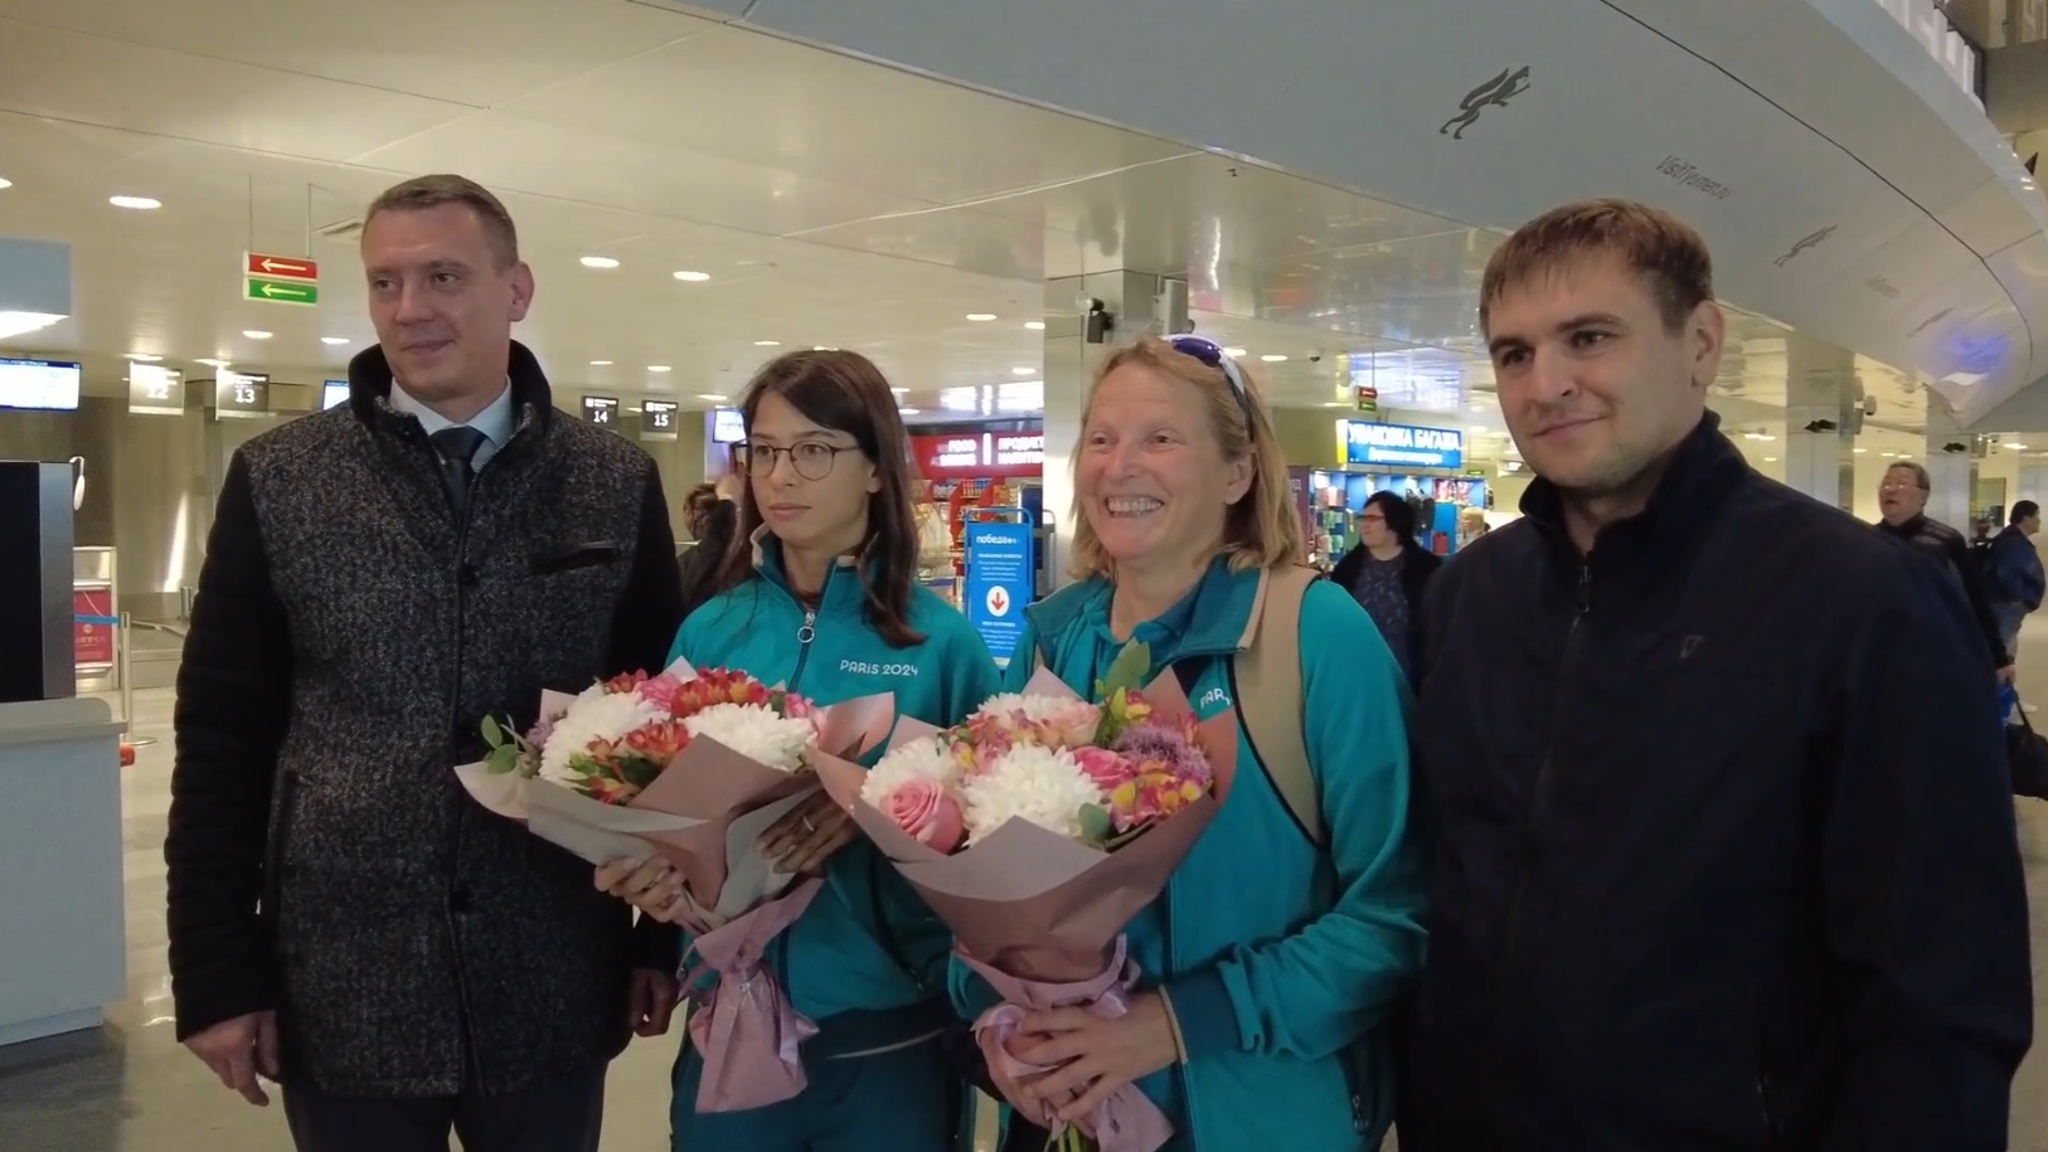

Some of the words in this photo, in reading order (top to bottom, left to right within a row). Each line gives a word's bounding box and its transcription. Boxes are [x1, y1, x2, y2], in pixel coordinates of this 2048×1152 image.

[235, 388, 254, 403] 13
[593, 410, 608, 423] 14
[654, 414, 669, 427] 15
[840, 659, 879, 675] PARIS
[882, 664, 918, 676] 2024
